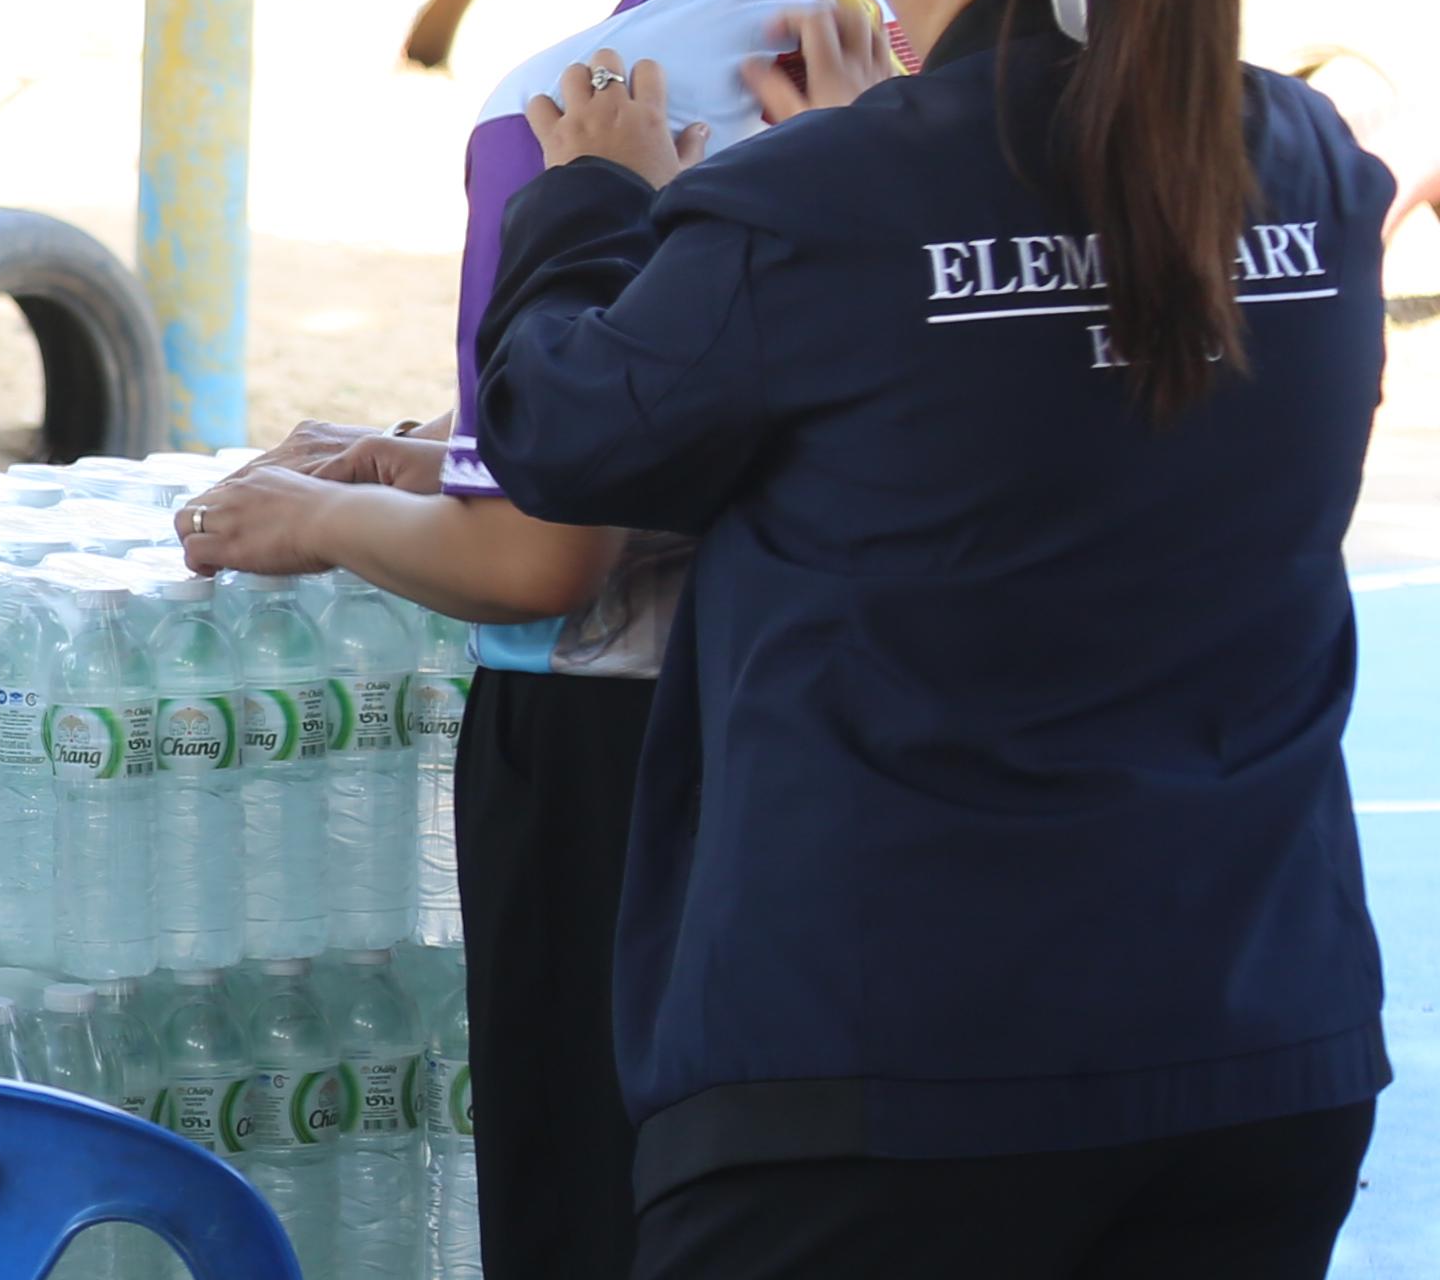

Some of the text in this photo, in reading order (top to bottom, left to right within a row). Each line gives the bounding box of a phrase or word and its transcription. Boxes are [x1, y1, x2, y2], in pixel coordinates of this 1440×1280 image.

[923, 221, 1326, 302] ELEMARY
[160, 736, 221, 760] Chang
[244, 731, 278, 751] ang
[309, 1109, 338, 1130] Cha
